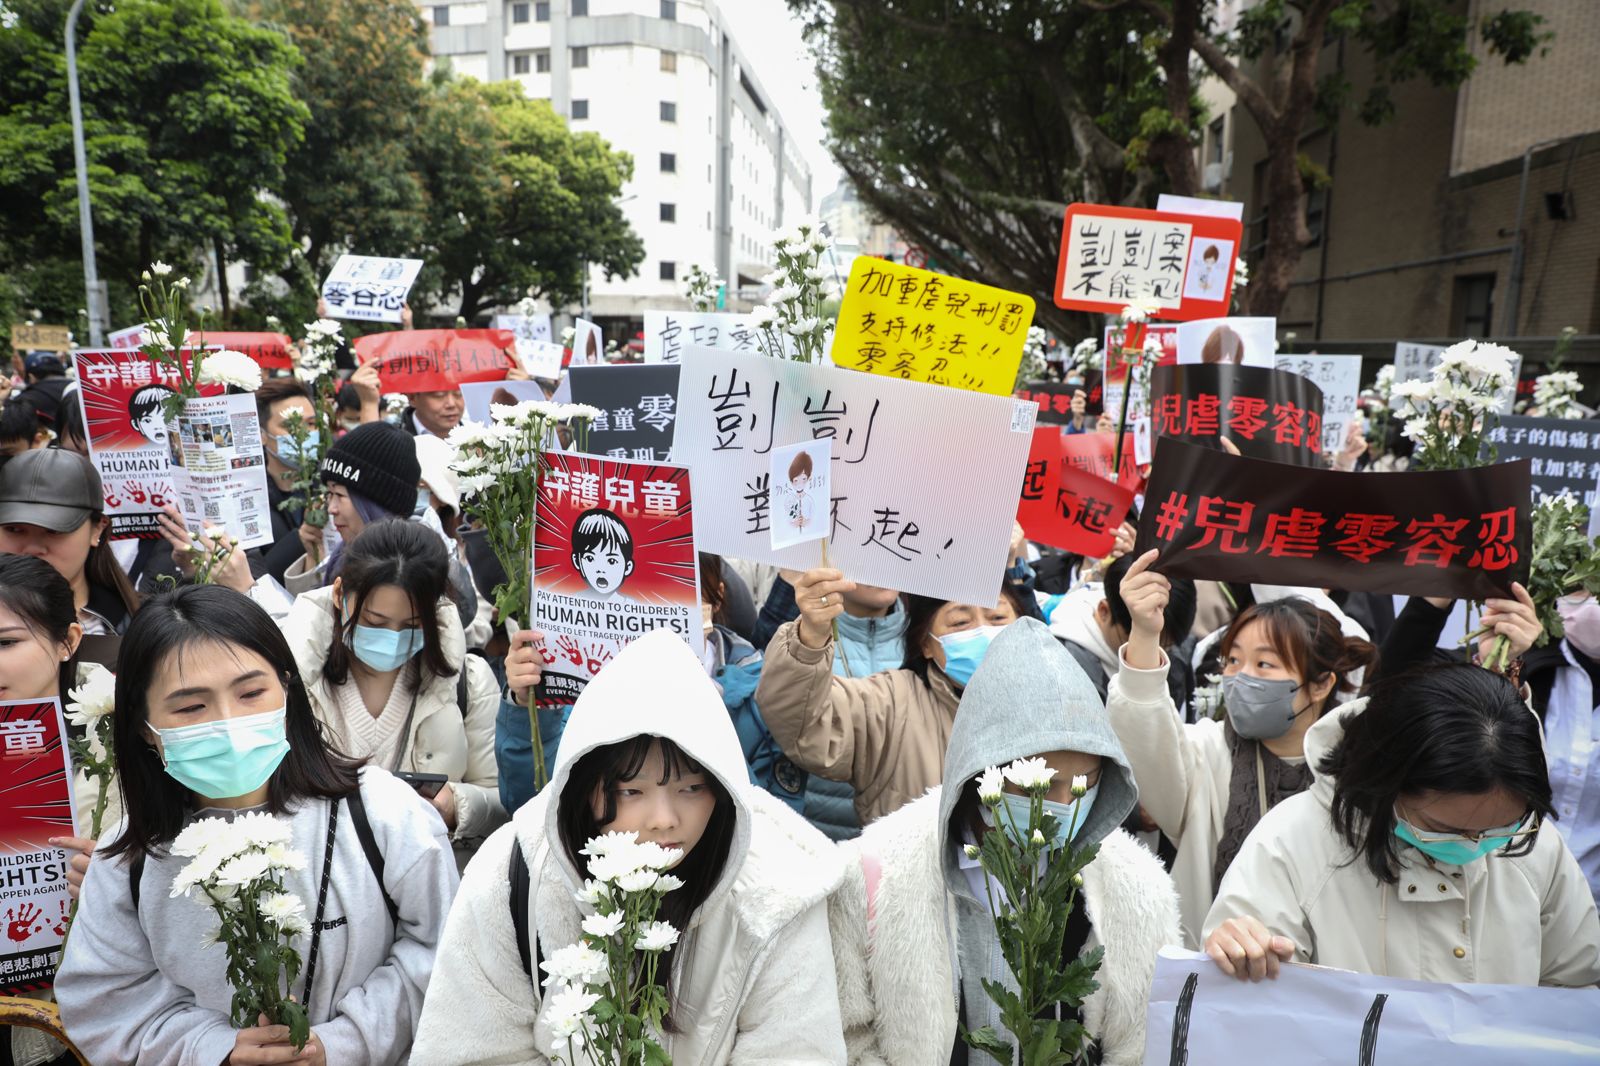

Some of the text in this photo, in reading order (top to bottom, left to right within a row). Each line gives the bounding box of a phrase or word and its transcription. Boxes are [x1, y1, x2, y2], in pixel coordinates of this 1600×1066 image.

[859, 267, 1023, 335] 加重虐兒刑罰
[101, 459, 159, 472] HUMAN
[116, 450, 163, 458] ATTENTION
[543, 467, 681, 519] 守護兒童
[1155, 491, 1519, 571] #兒虐零容忍
[536, 602, 600, 628] HUMAN
[537, 590, 689, 616] PAY ATTENTION TO CHILDREN'S
[536, 621, 561, 632] REFUSE
[574, 628, 586, 637] LET
[589, 631, 624, 641] TRAGEDY
[7, 970, 43, 983] HUMAN
